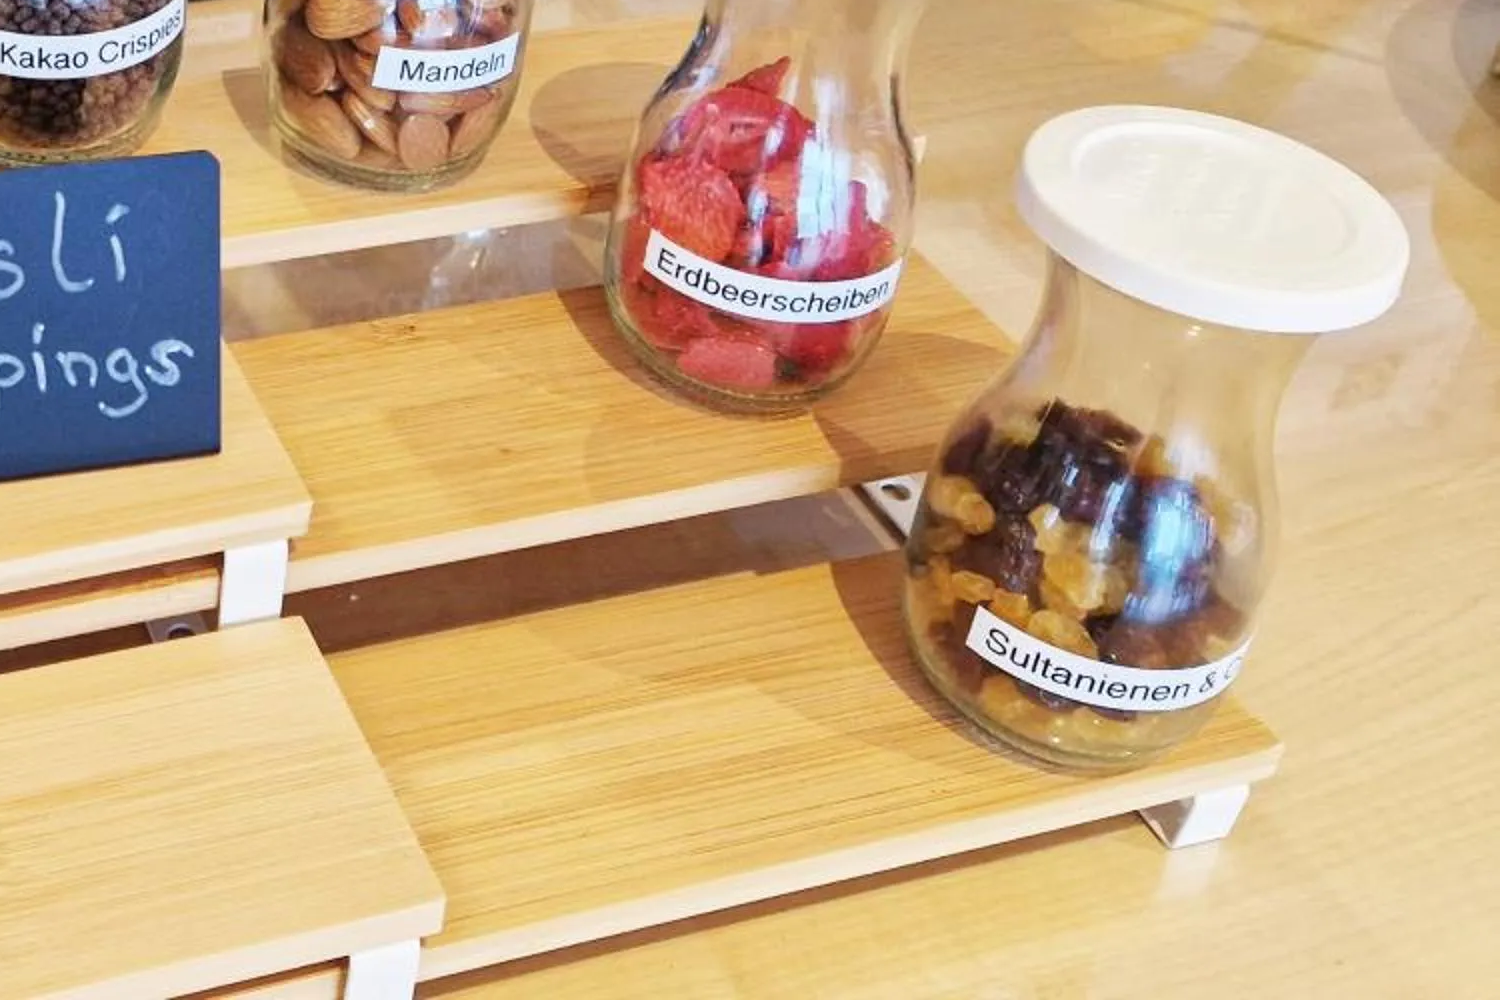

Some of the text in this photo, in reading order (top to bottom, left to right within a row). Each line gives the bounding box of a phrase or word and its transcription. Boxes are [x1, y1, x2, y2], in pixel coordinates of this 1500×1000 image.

[0, 9, 182, 70] Kakao Crispies
[399, 52, 506, 83] Mandeln
[655, 247, 890, 314] Erdbeerscheiben
[984, 628, 1191, 702] Sultanienen
[1199, 672, 1219, 694] &
